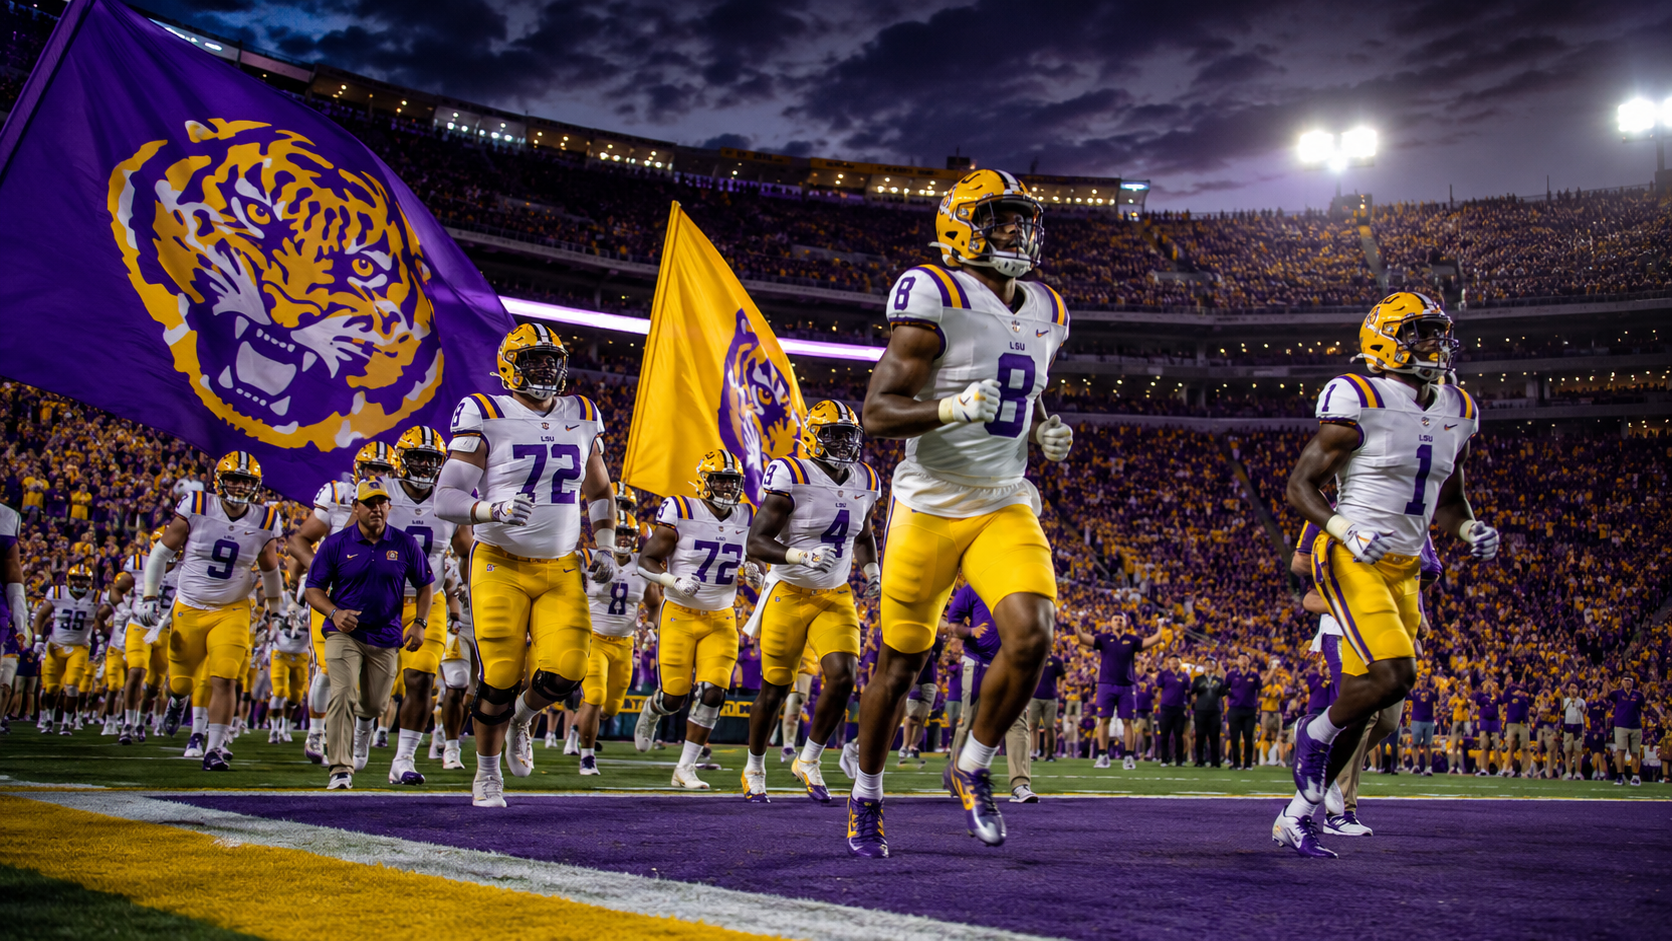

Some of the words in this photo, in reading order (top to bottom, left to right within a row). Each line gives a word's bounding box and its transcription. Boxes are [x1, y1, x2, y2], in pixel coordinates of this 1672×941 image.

[893, 276, 917, 311] 8
[1009, 341, 1026, 351] LSU
[984, 352, 1036, 439] 8
[1321, 383, 1337, 412] 1
[1419, 434, 1434, 443] LSU
[512, 443, 582, 504] 72
[1404, 444, 1433, 516] 1
[820, 509, 850, 558] 4
[207, 538, 240, 580] 9
[693, 539, 744, 585] 72
